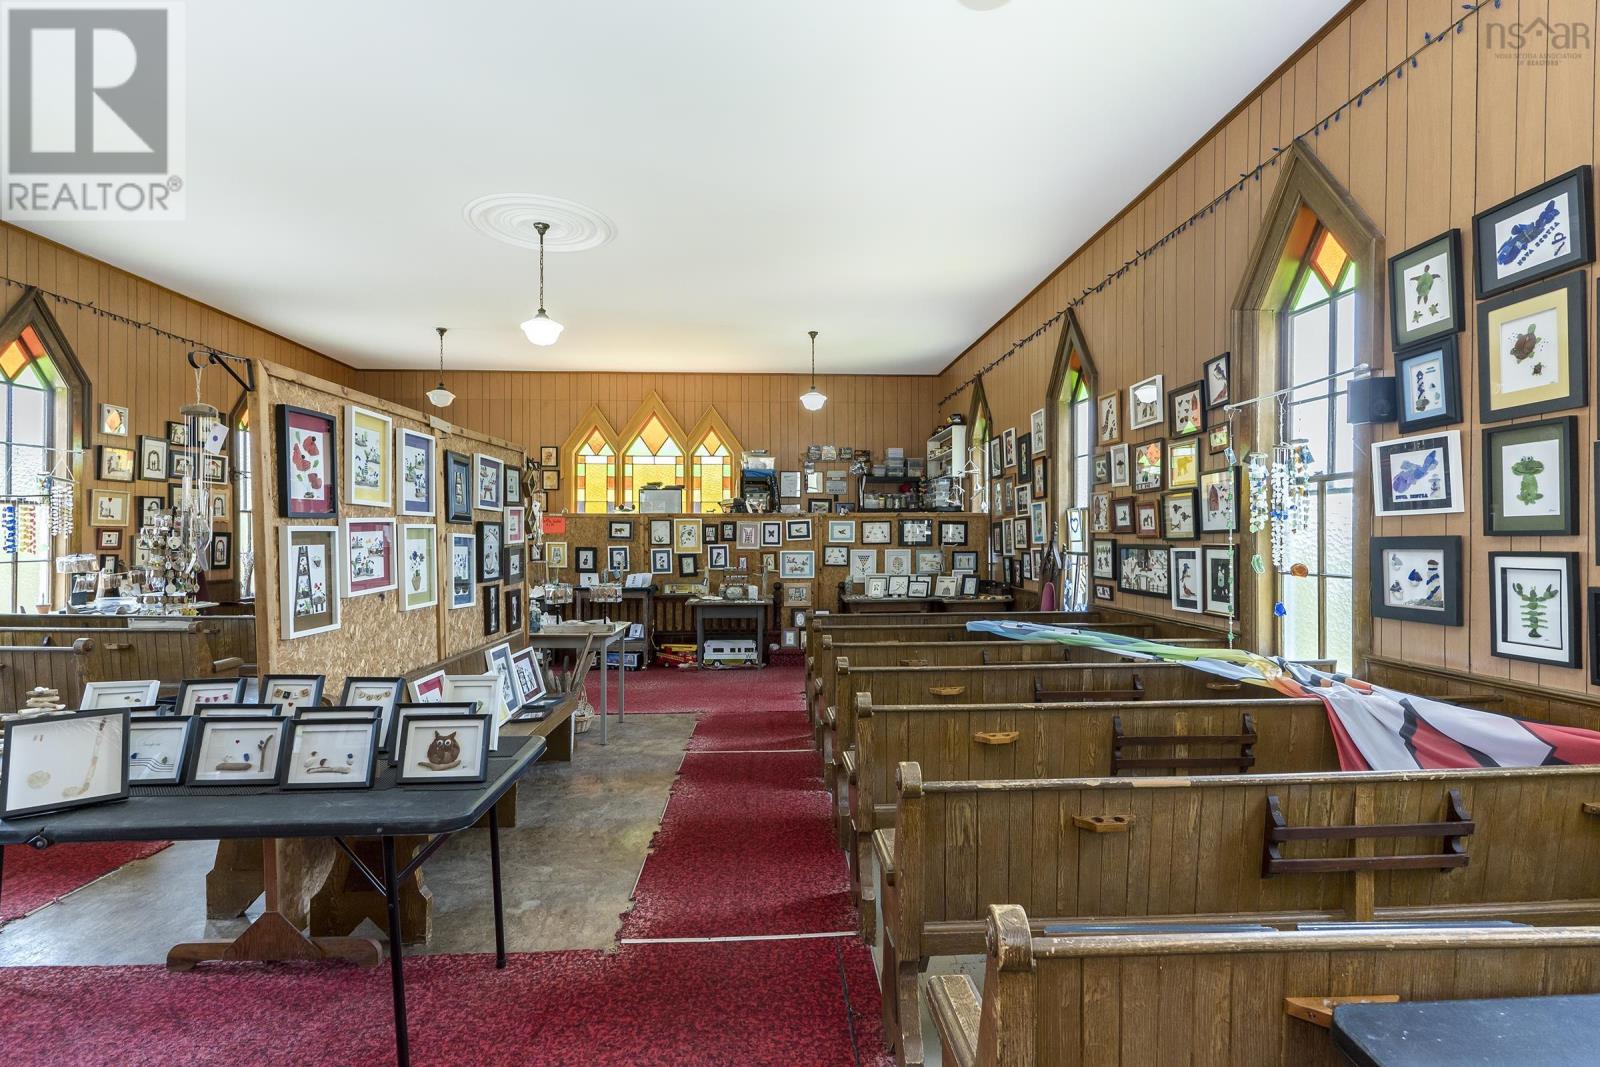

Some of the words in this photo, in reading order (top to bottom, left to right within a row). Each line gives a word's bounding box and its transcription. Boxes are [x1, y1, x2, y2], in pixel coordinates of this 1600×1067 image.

[1517, 249, 1534, 266] NOVA
[1535, 221, 1560, 247] SCOTIA
[195, 693, 229, 703] LOVE
